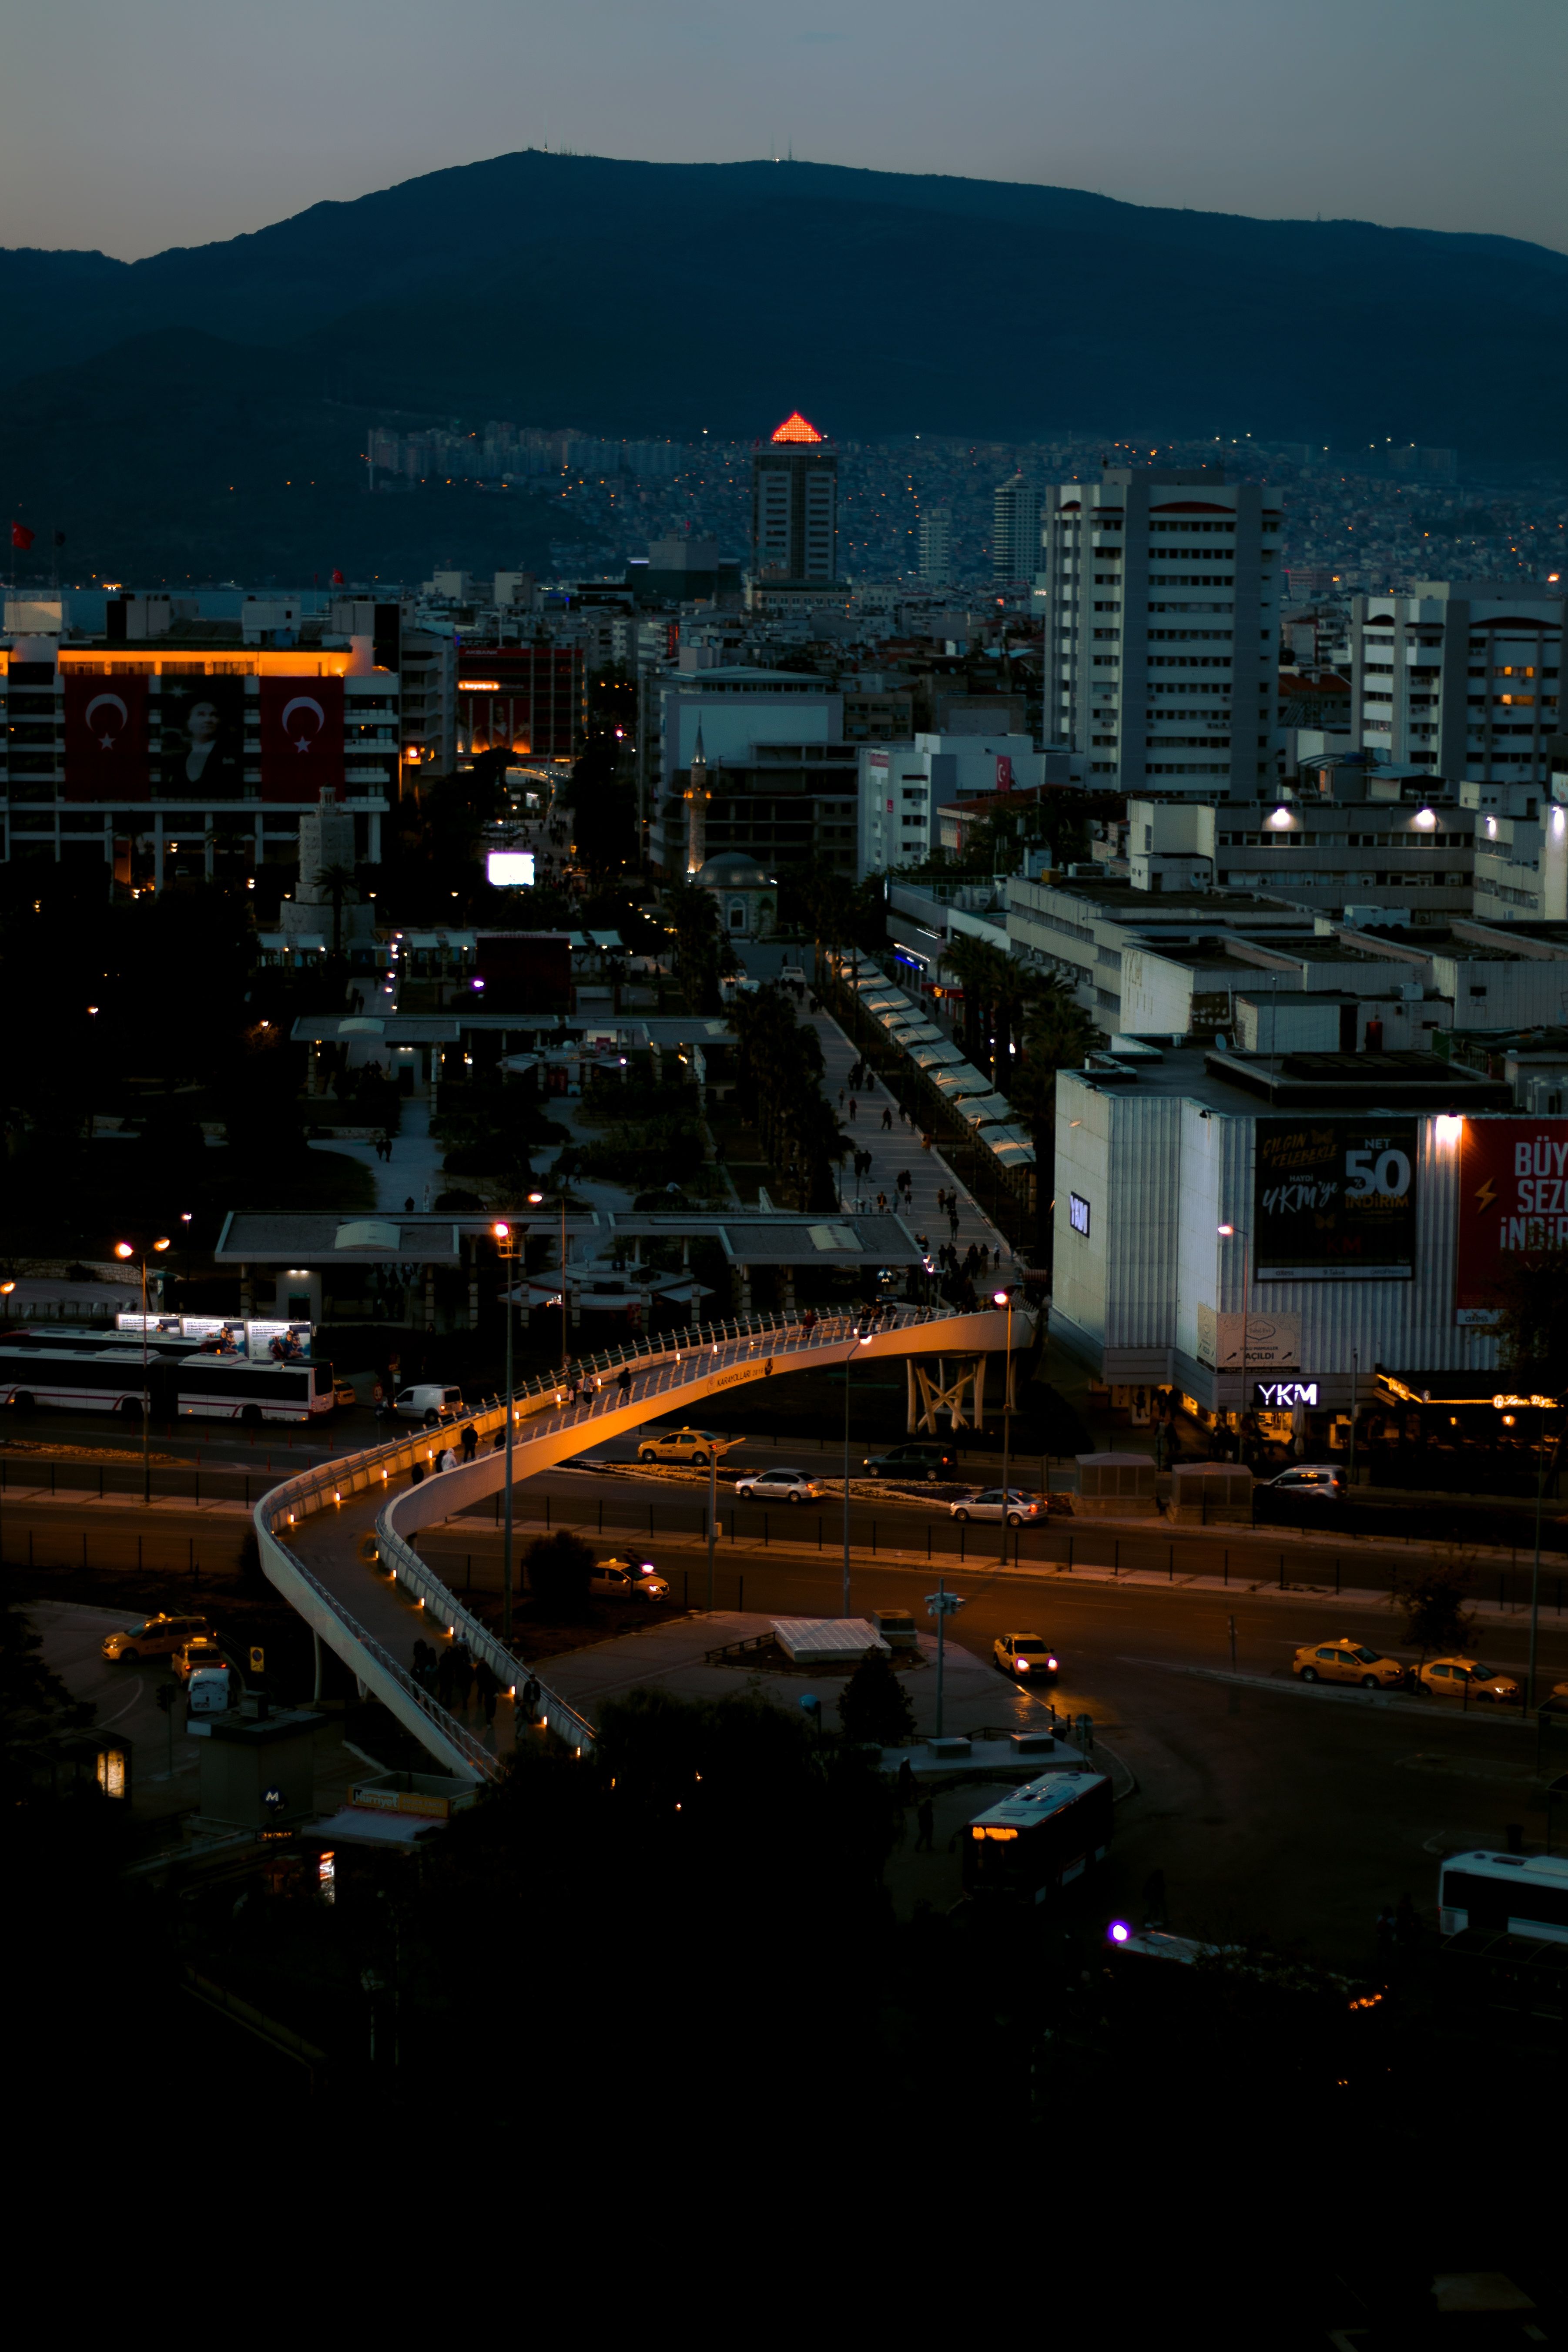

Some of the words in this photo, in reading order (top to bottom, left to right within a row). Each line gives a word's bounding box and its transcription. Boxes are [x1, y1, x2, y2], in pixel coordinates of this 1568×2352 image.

[1364, 1138, 1391, 1149] NET
[1514, 1135, 1568, 1177] BÜY
[1289, 1173, 1314, 1183] HAYDİ
[1517, 1179, 1568, 1213] SEZ
[1246, 1353, 1274, 1361] AÇILDI
[717, 1370, 751, 1387] KARAYOLLARI
[1258, 1384, 1317, 1406] YKM
[266, 1791, 279, 1802] M
[268, 1831, 293, 1839] KONAK
